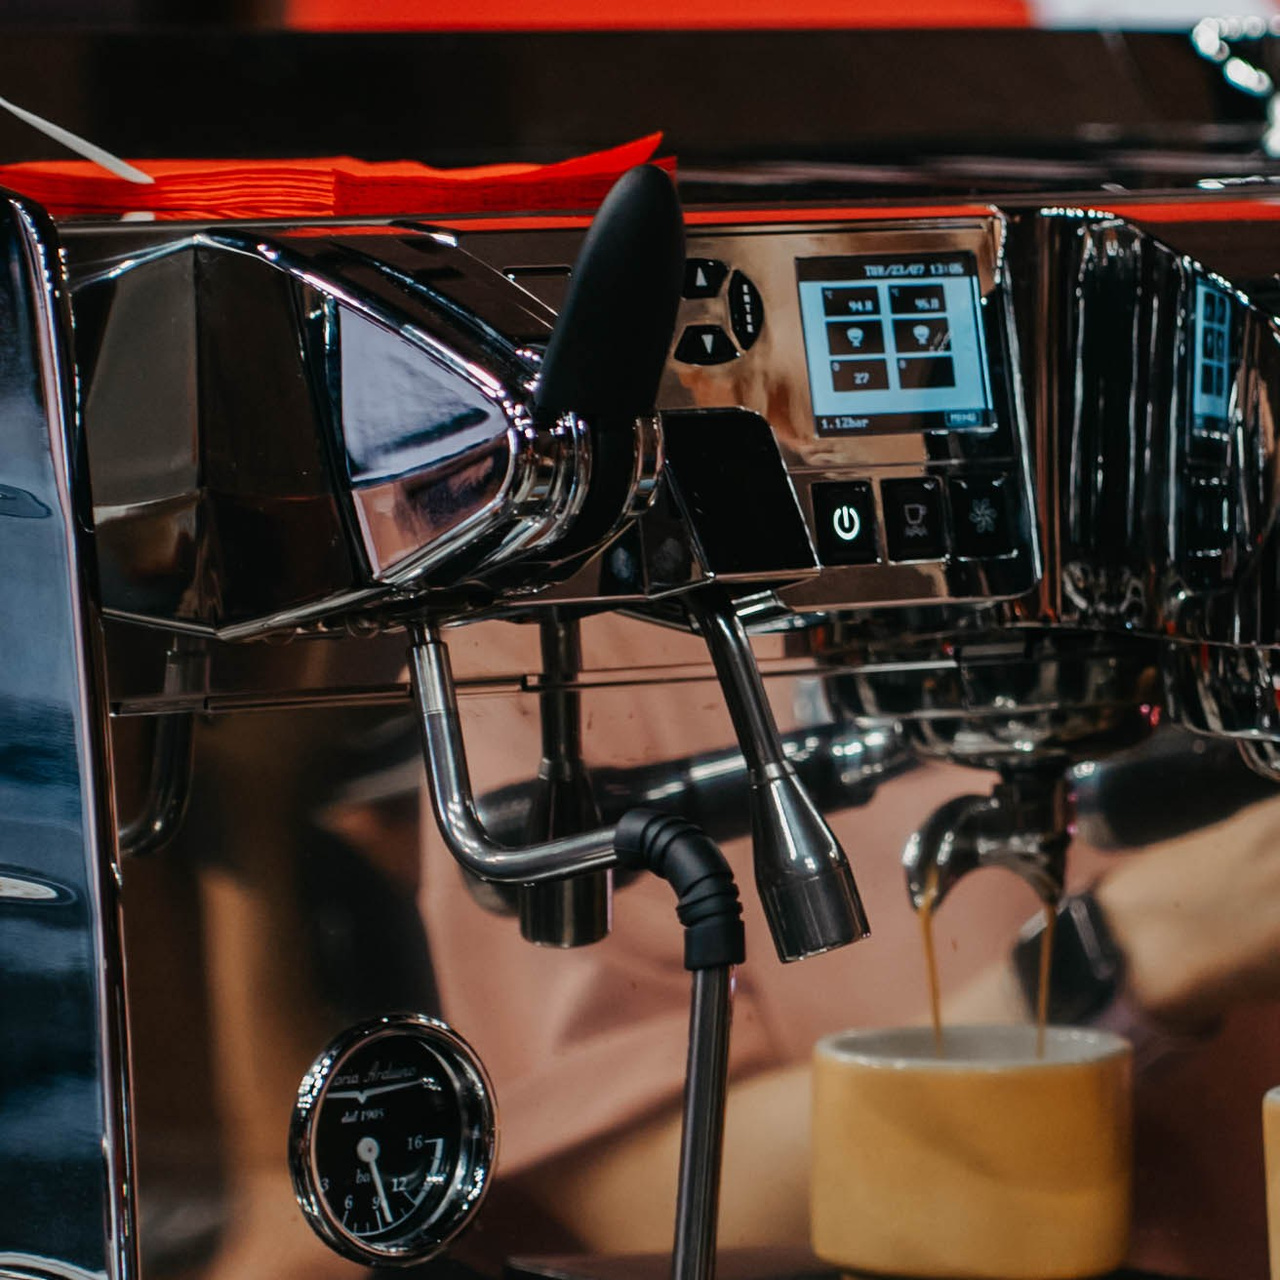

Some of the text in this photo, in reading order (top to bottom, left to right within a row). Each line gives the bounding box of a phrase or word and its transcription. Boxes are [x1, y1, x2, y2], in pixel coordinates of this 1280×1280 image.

[742, 284, 754, 333] ENTER
[407, 1134, 423, 1150] 16
[391, 1177, 408, 1192] 12
[344, 1195, 353, 1210] 6
[372, 1196, 381, 1210] 9
